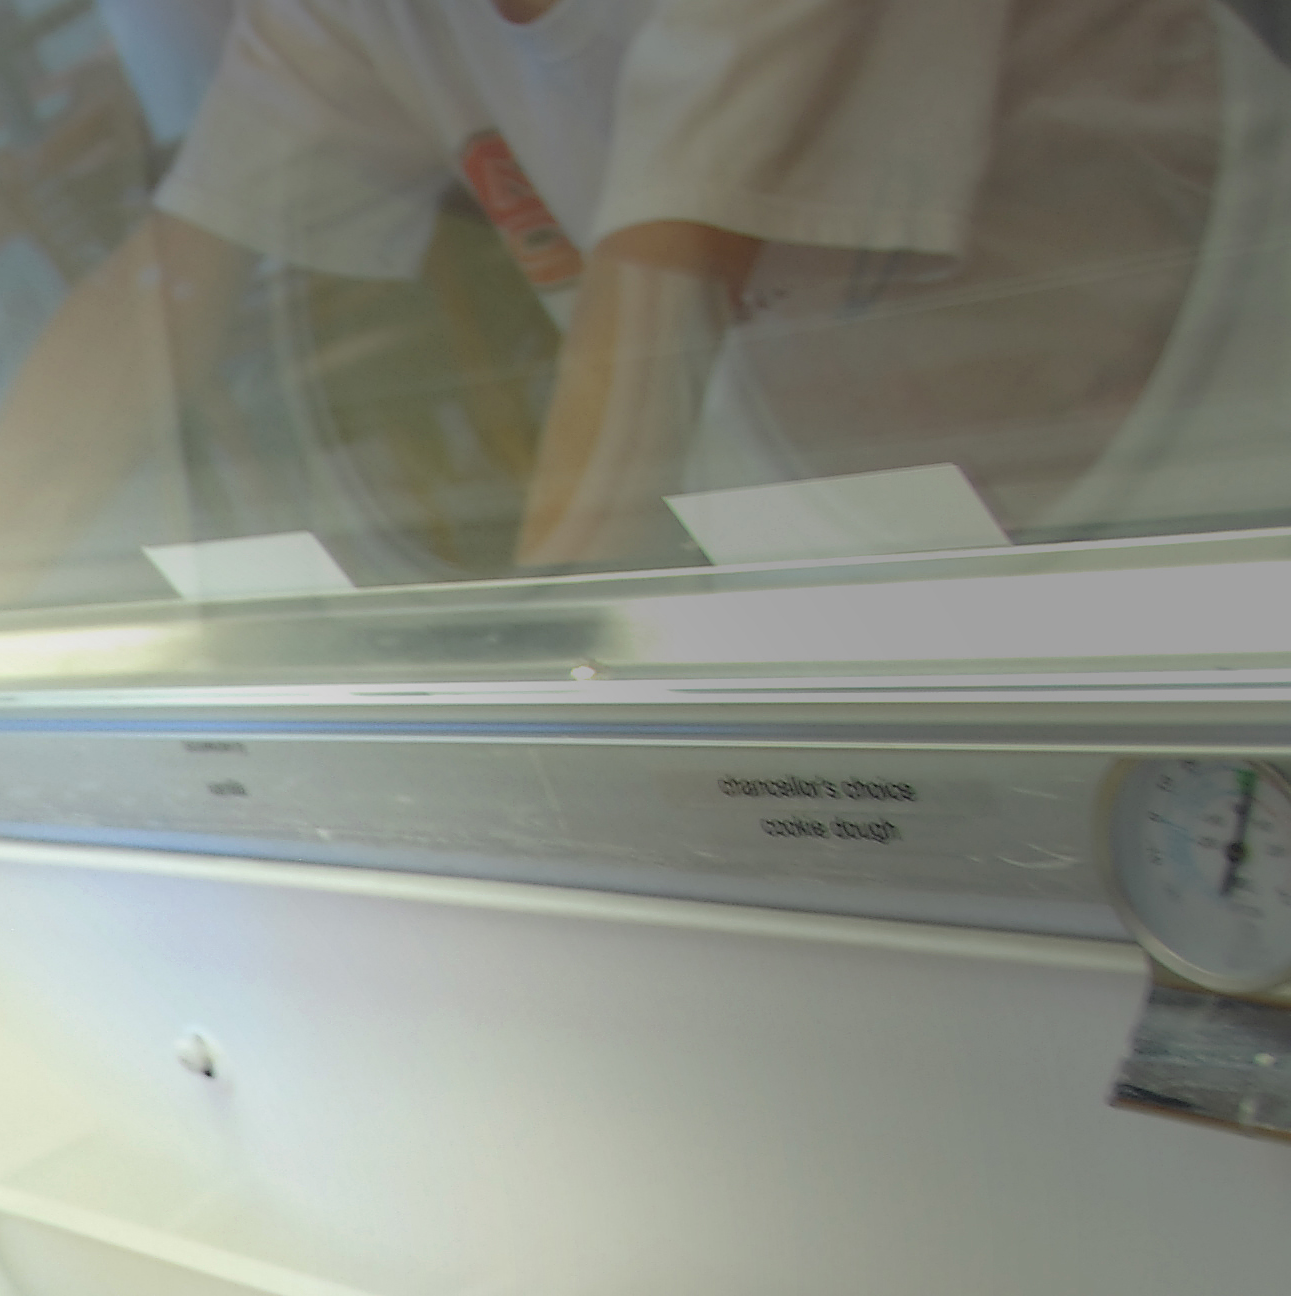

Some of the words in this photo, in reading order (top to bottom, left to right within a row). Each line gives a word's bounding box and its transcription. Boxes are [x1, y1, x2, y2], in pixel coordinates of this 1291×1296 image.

[839, 776, 917, 802] choice
[760, 813, 830, 839] cookie
[829, 815, 904, 846] dough
